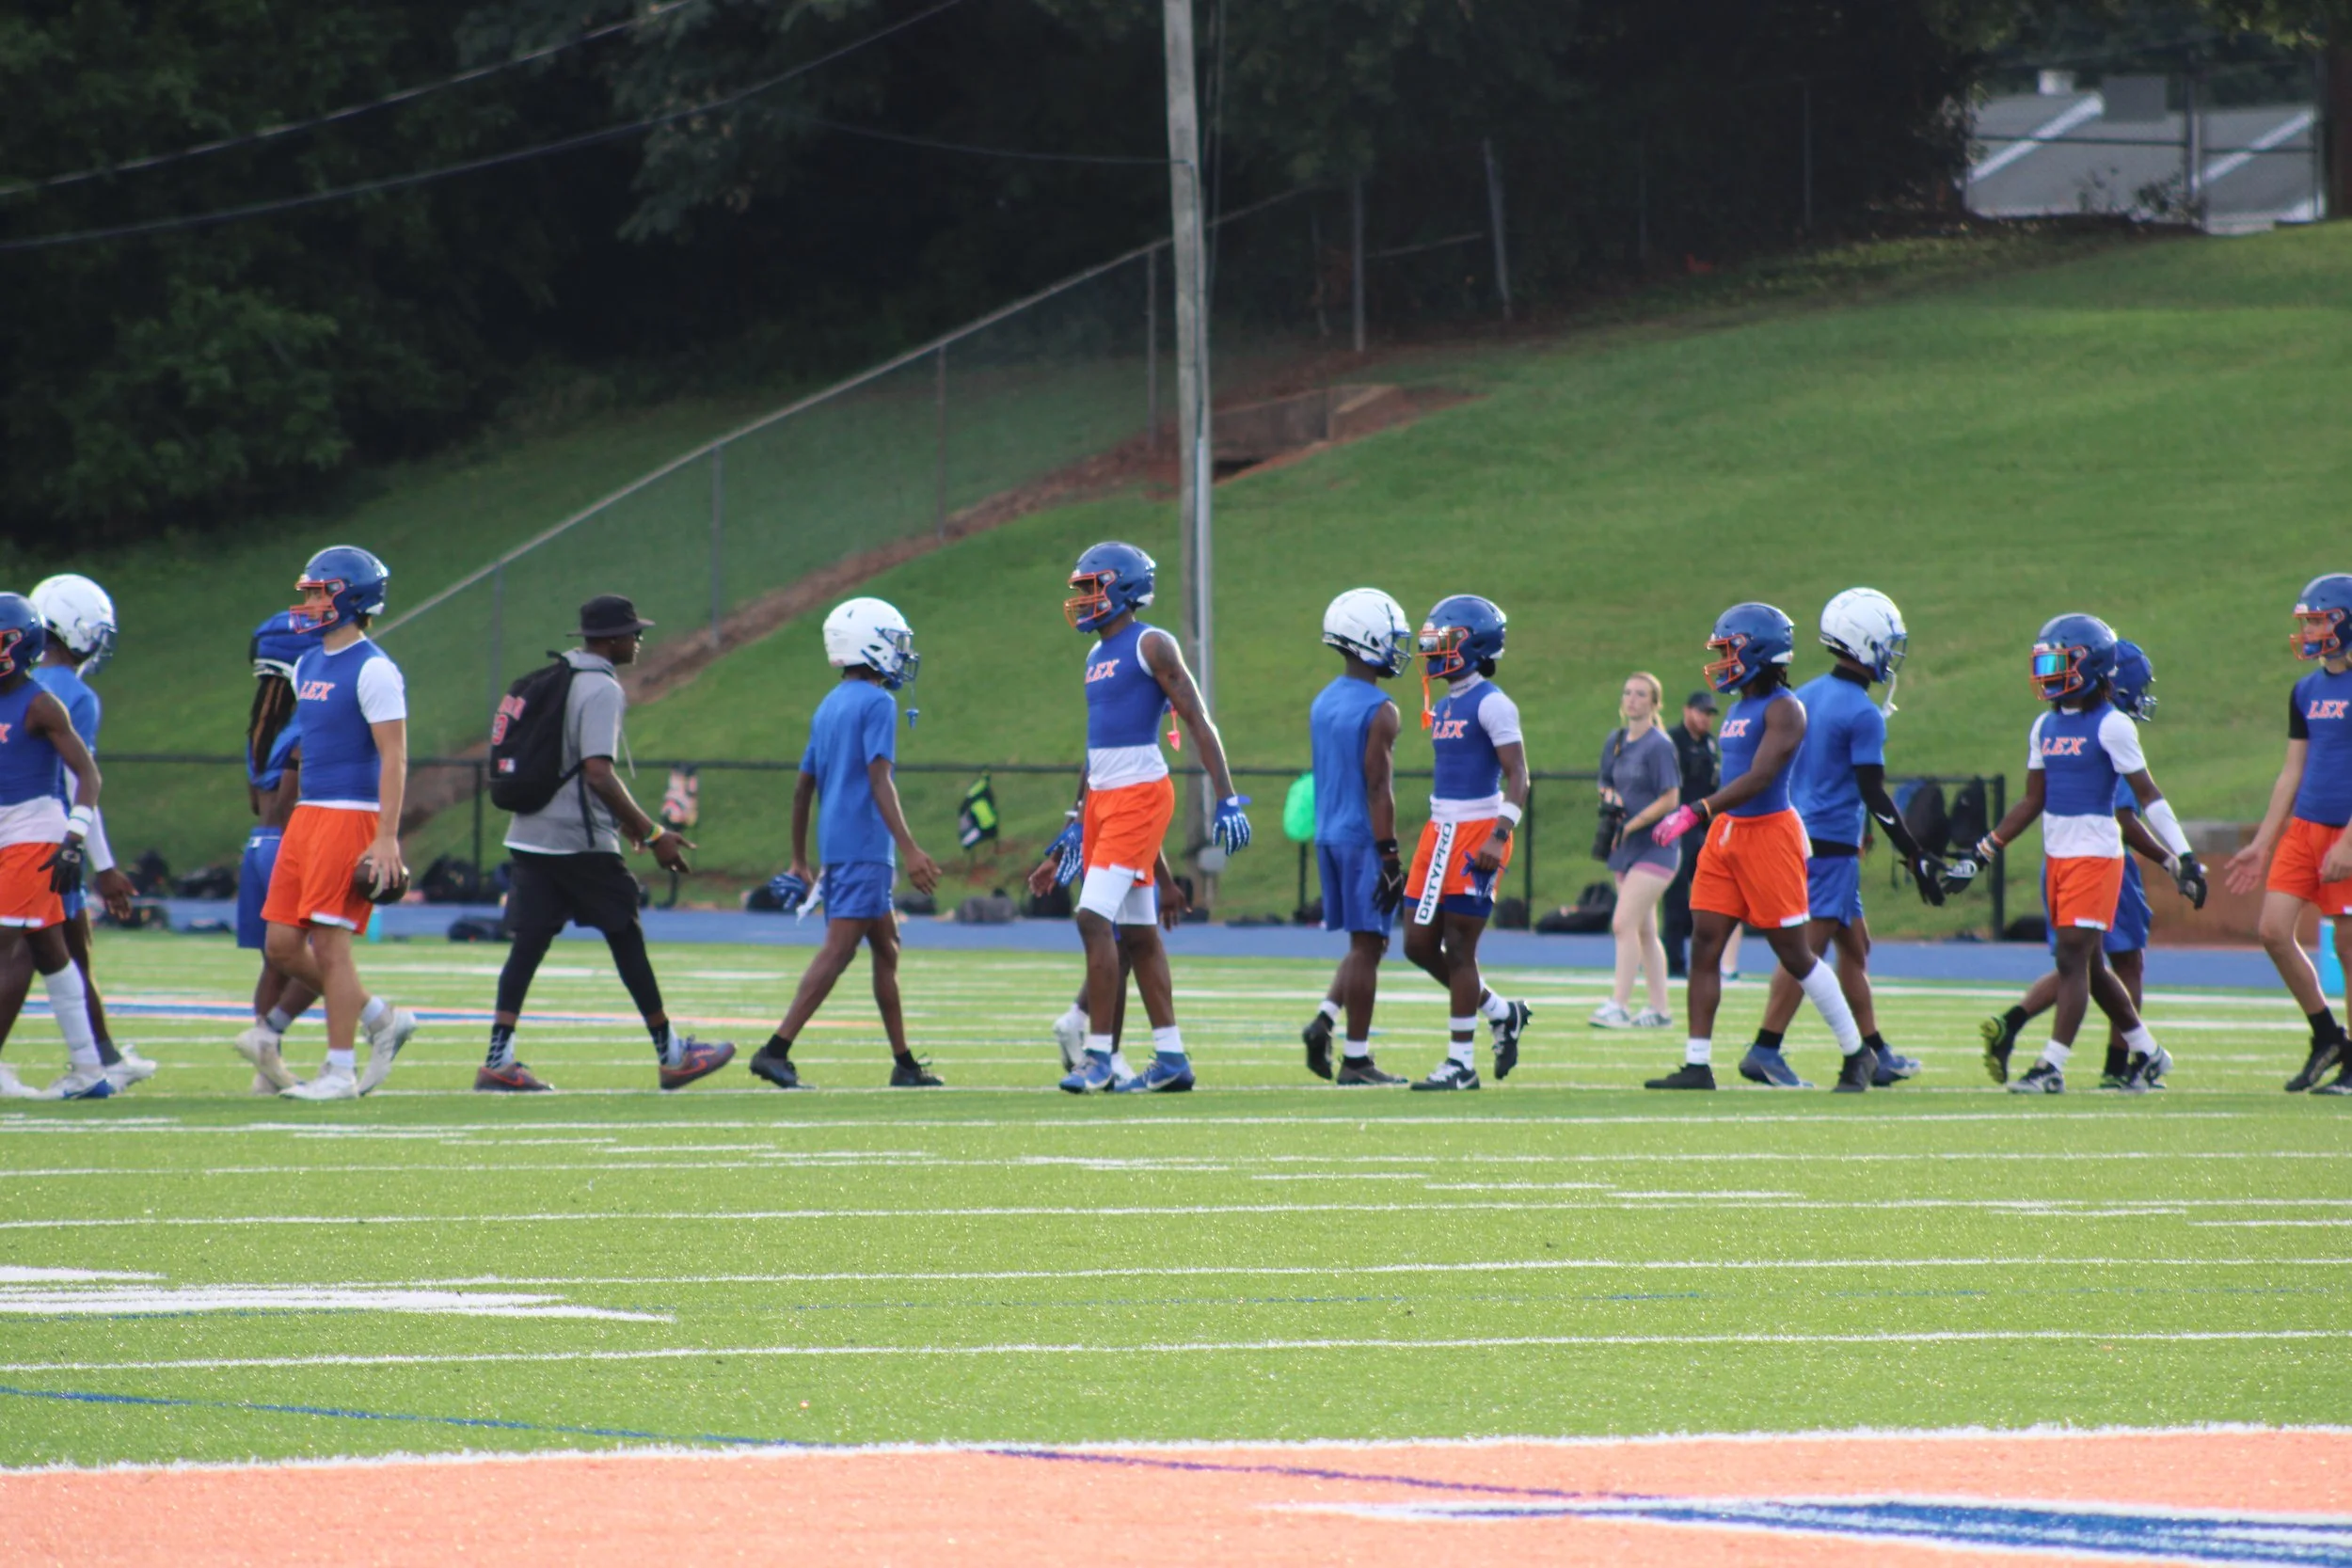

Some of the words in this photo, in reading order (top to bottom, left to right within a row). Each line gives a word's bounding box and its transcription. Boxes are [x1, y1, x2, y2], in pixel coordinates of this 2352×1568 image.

[1084, 658, 1120, 684] LEX
[299, 680, 335, 701] LEX
[2307, 700, 2349, 719] LEX
[1432, 720, 1468, 738] LEX
[1720, 719, 1751, 738] LEX
[2042, 736, 2087, 755] LEX
[1418, 823, 1452, 920] DRTYPRO
